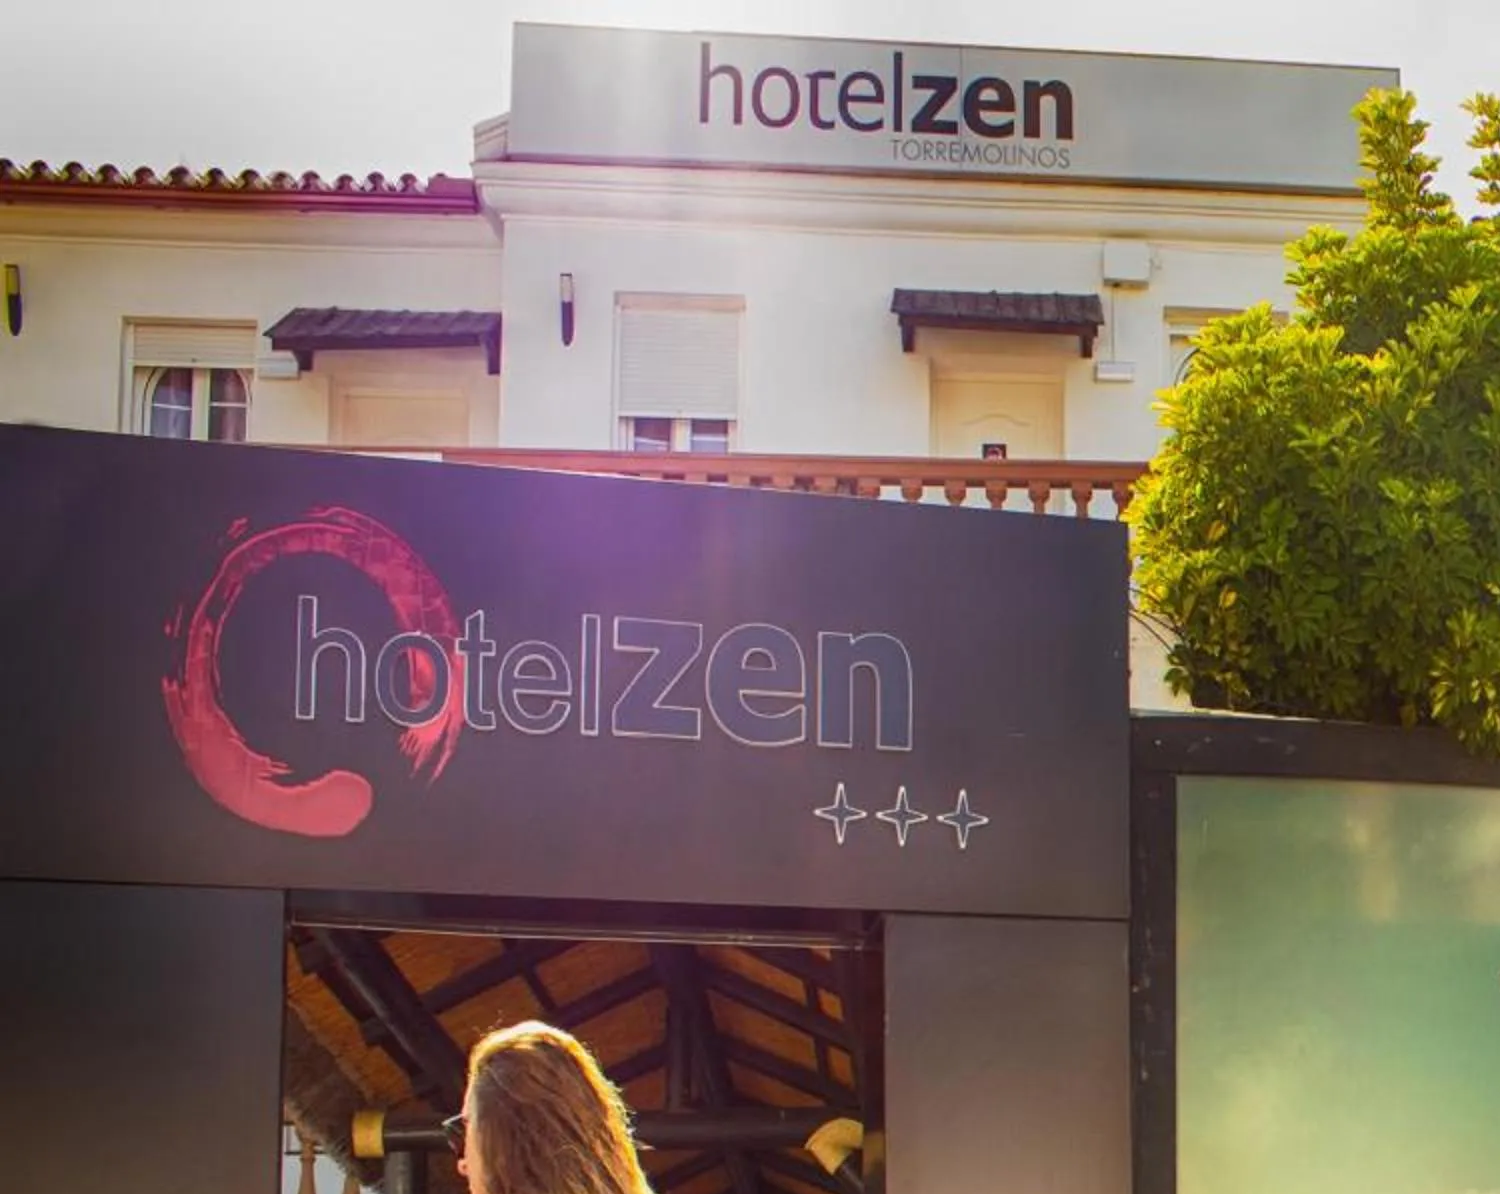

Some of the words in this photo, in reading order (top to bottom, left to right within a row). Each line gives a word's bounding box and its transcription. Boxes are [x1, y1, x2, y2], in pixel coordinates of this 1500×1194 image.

[699, 41, 1074, 140] hotelzen
[891, 139, 1071, 169] TORREMOLINOS
[294, 595, 914, 750] hotelzen
